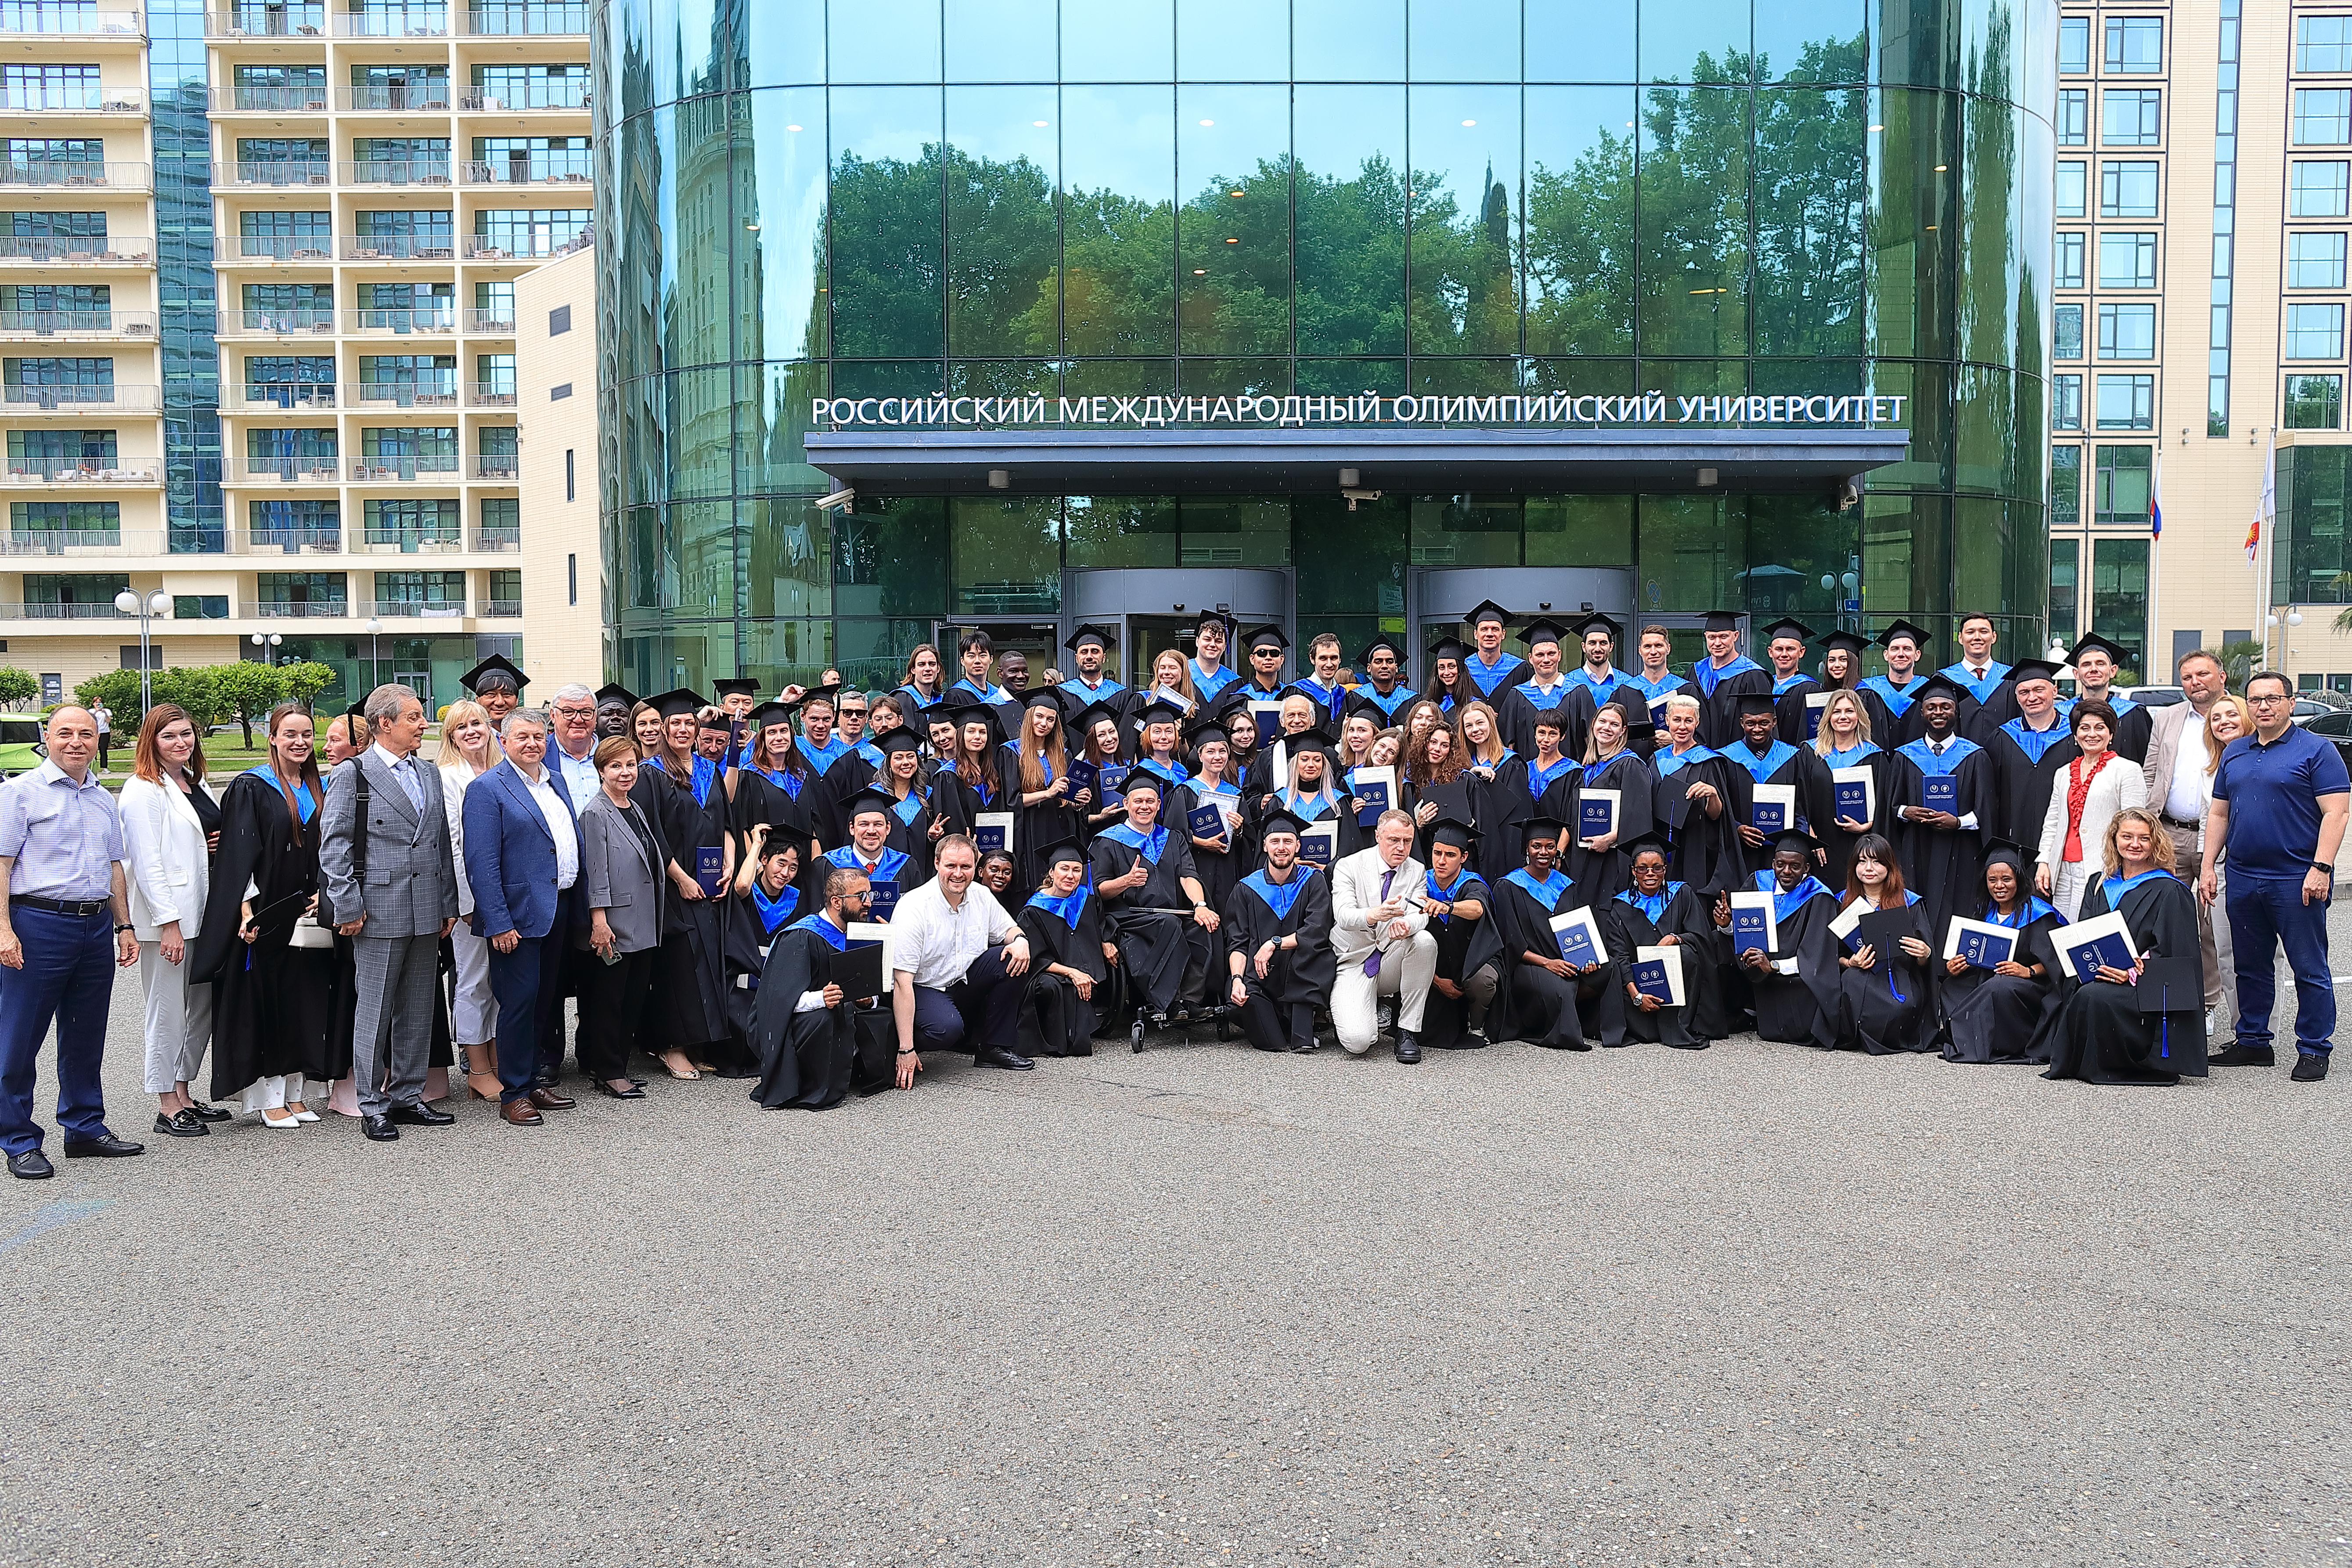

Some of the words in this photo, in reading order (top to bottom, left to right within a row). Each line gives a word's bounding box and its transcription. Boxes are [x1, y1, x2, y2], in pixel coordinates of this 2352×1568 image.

[812, 391, 1045, 425] РОССИЙСКИЙ
[1059, 389, 1380, 427] МЕЖДУНАРОДНЫЙ
[1393, 389, 1665, 423] ОЛИМПИЙСКИЙ
[1677, 396, 1907, 423] УНИВЕРСИТЕТ
